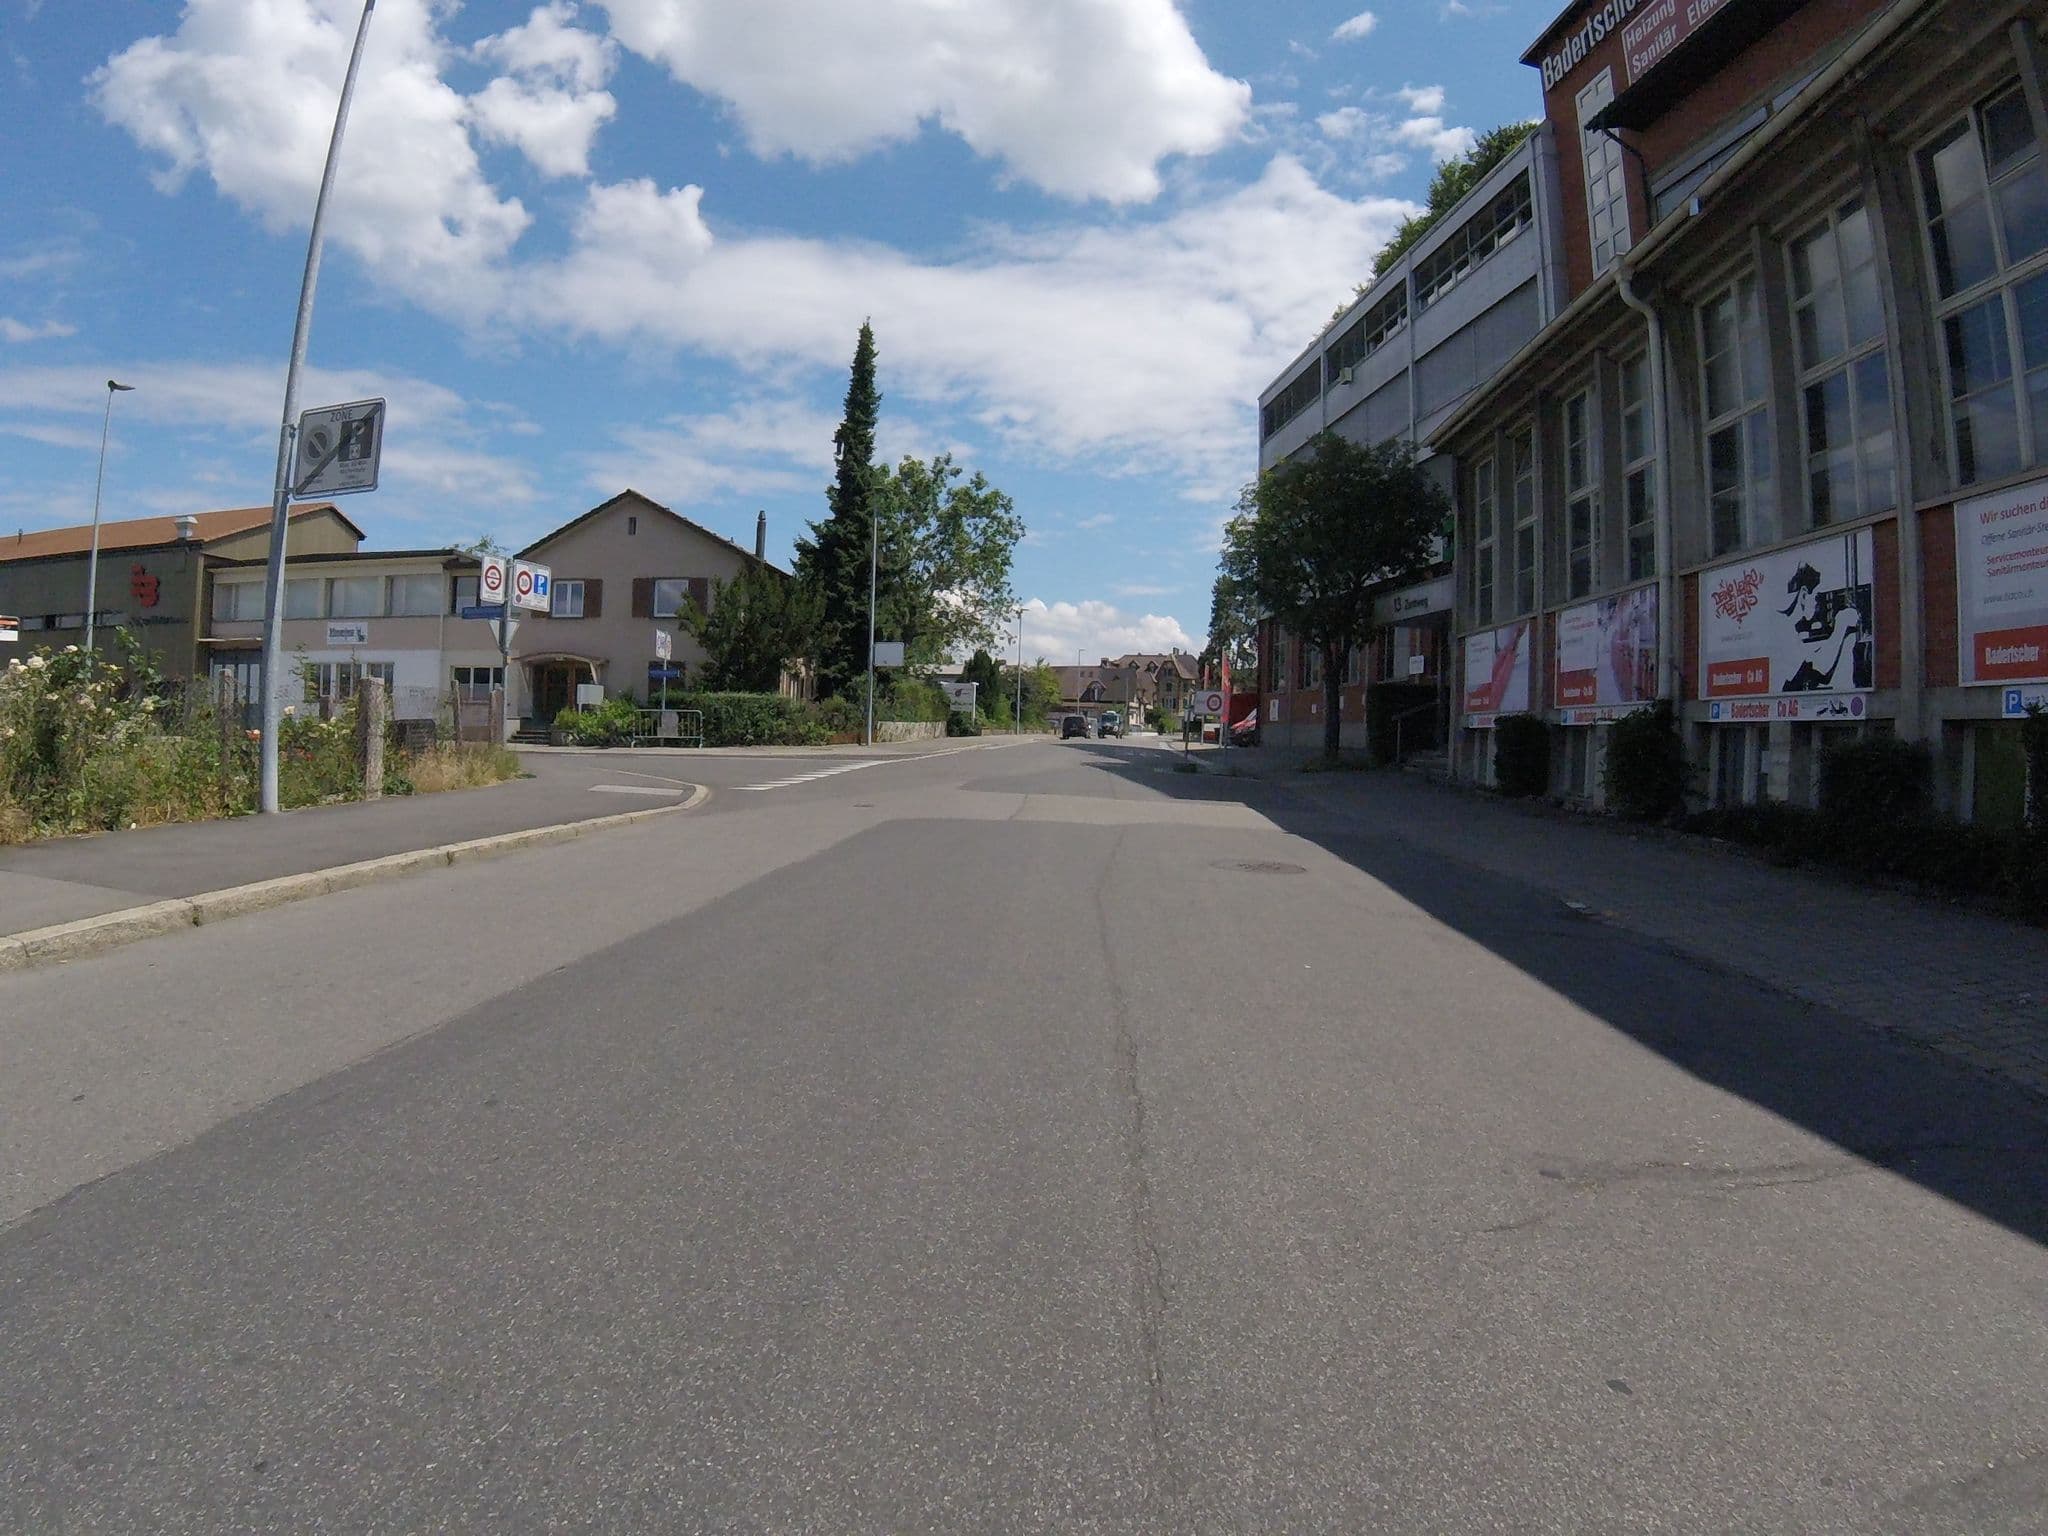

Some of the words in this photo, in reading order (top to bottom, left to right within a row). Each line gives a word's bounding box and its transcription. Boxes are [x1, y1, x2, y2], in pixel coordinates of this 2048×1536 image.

[1625, 0, 1676, 50] Heizung
[1631, 24, 1678, 74] Sanitär
[330, 410, 353, 422] ZONE
[1979, 511, 1998, 524] Wir
[2000, 502, 2037, 520] suchen
[1788, 698, 1799, 717] AG
[2009, 694, 2018, 710] P
